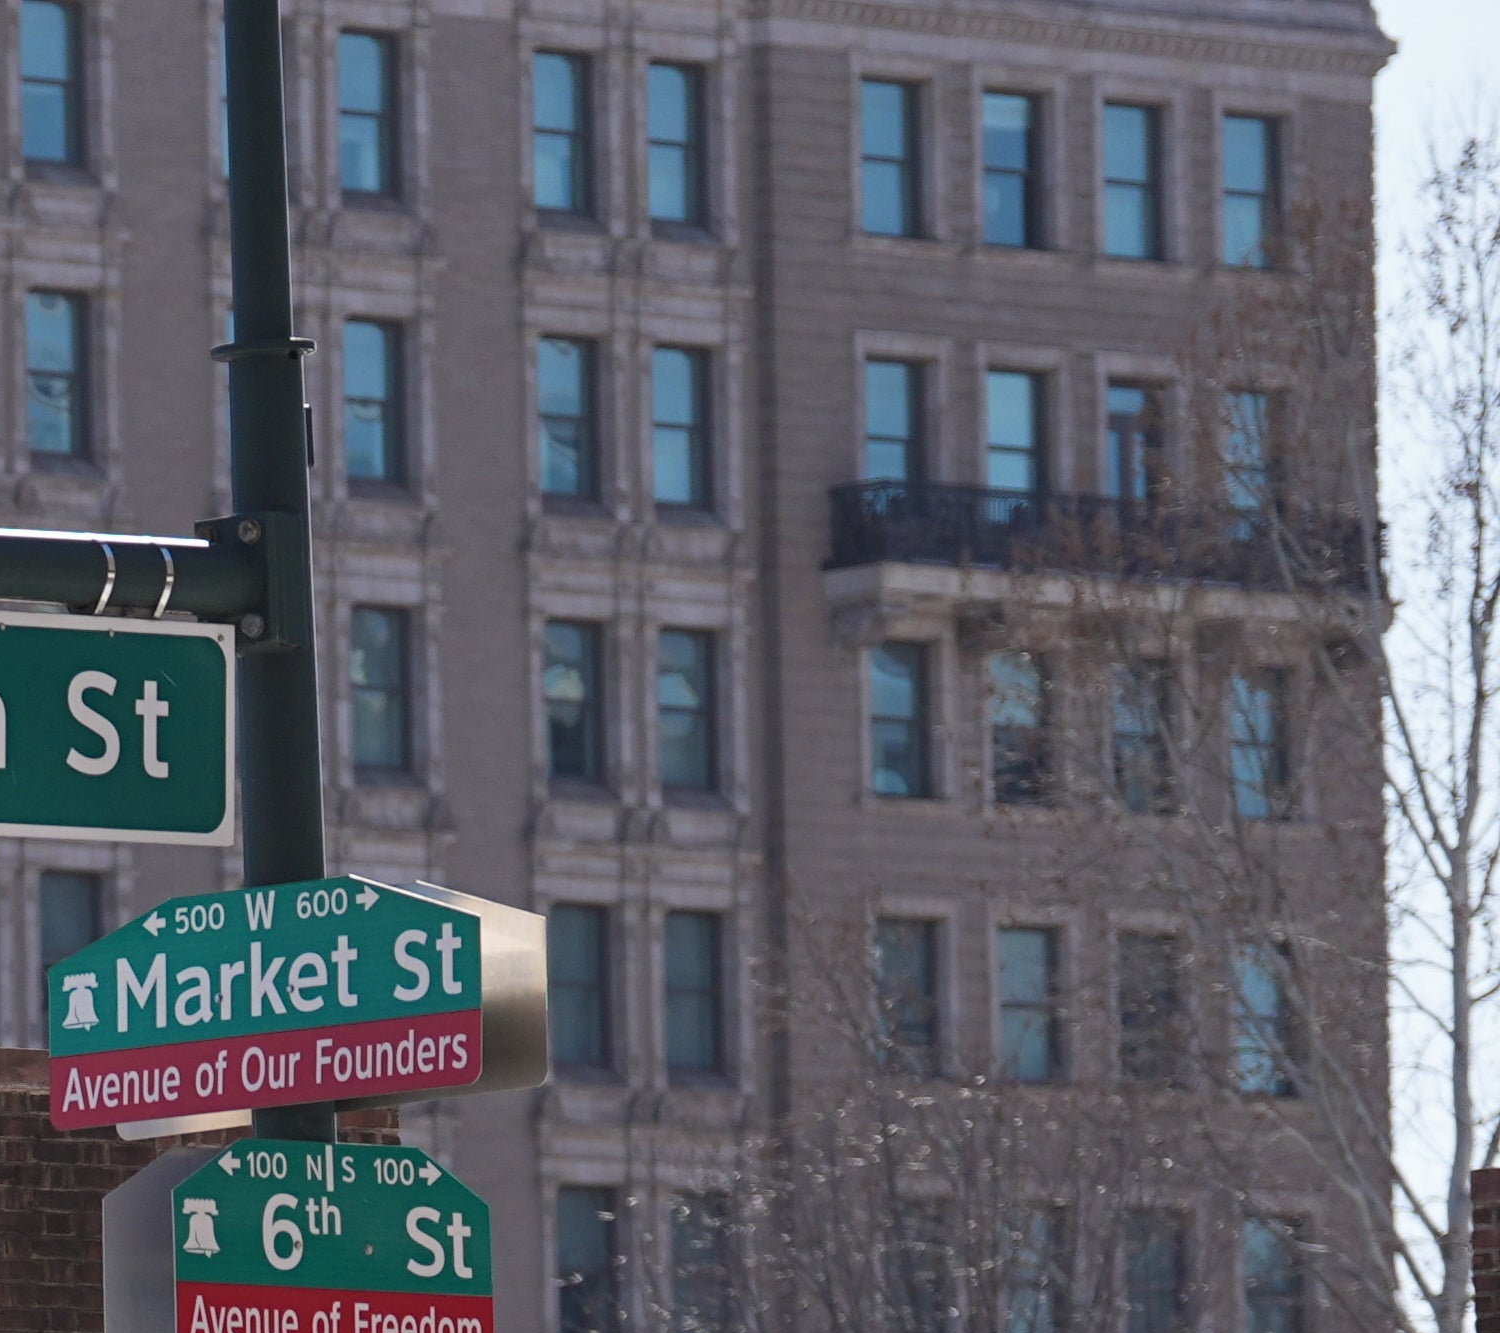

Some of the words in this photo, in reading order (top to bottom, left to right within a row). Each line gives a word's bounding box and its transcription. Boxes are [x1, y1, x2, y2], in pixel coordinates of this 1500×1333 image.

[65, 669, 171, 780] St
[173, 902, 226, 935] 500
[244, 890, 276, 932] W
[296, 887, 349, 920] 600
[115, 933, 359, 1034] Market
[392, 921, 464, 1003] St
[61, 1064, 181, 1113] Avenue
[194, 1049, 228, 1098] of
[240, 1045, 302, 1093] Our
[314, 1028, 469, 1086] Founders
[246, 1151, 288, 1180] 100
[305, 1154, 323, 1182] N
[341, 1156, 356, 1183] S
[373, 1158, 415, 1187] 100
[261, 1191, 342, 1272] 6th
[405, 1205, 474, 1280] St
